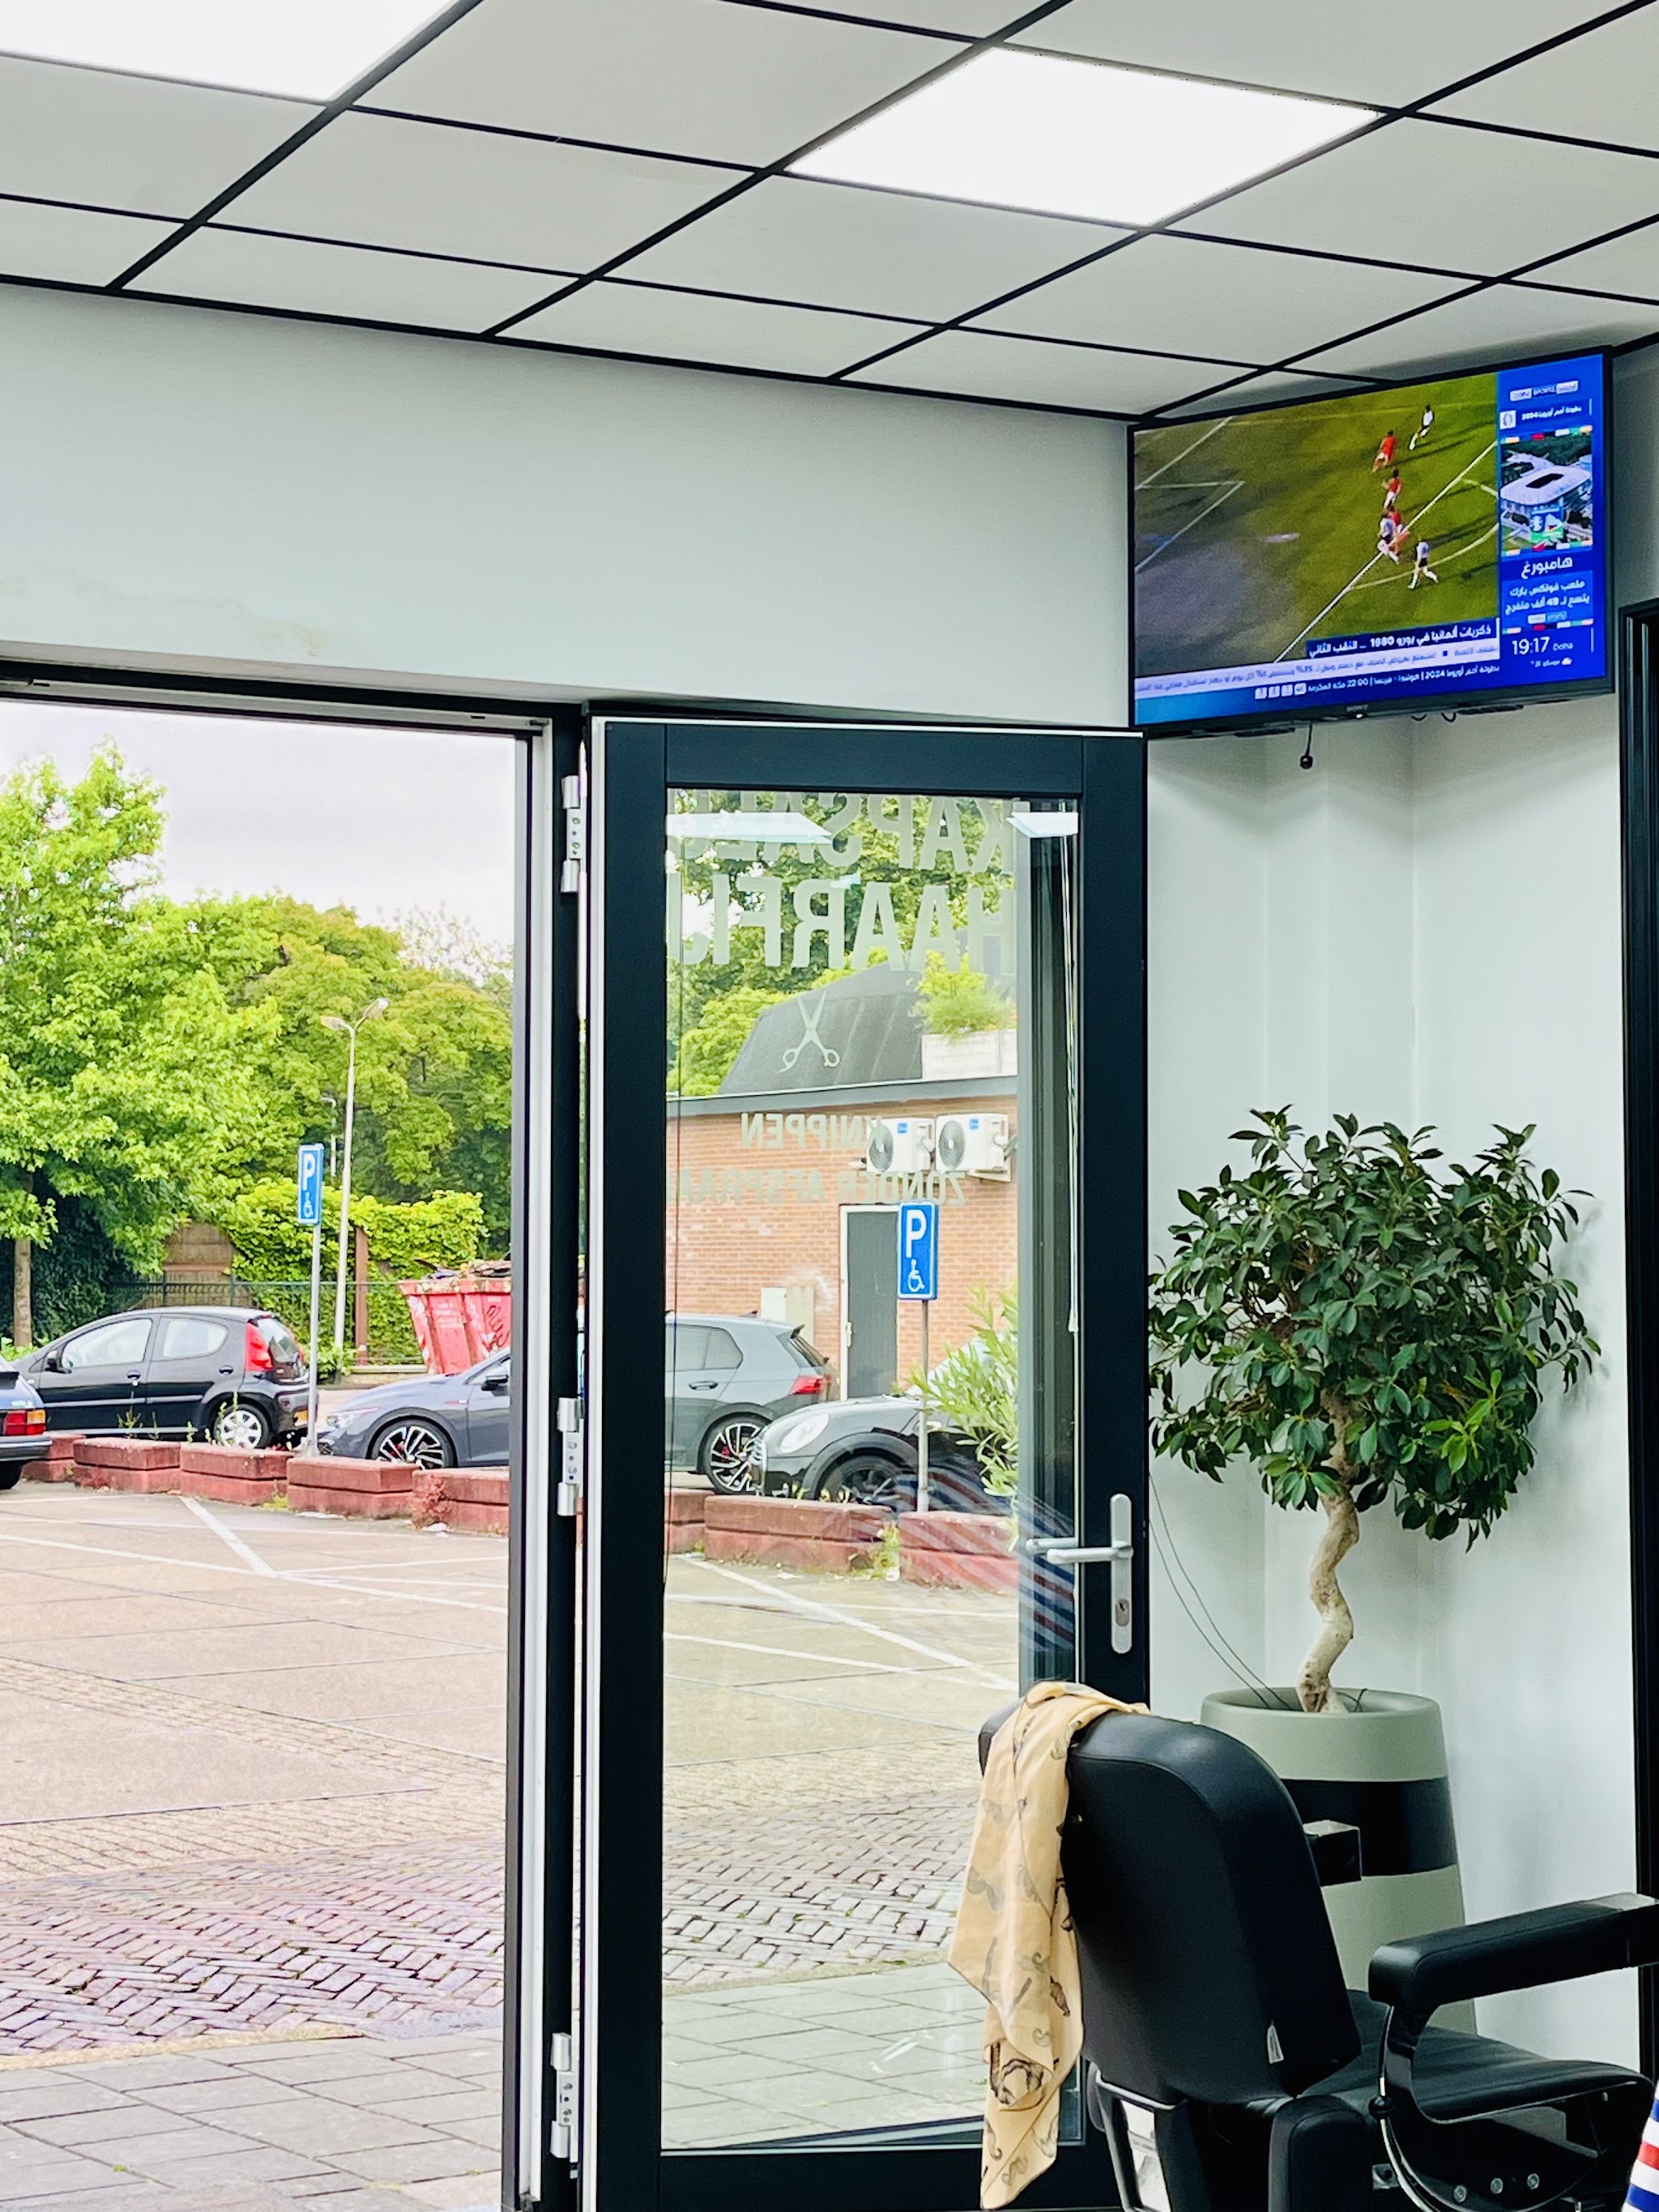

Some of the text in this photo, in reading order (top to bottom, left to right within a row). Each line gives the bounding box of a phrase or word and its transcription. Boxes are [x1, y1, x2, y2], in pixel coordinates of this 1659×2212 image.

[1521, 556, 1573, 580] هامبورغ
[1560, 580, 1586, 590] ملعب
[1531, 595, 1546, 608] ألف
[1567, 594, 1590, 607] يتسع
[1505, 601, 1529, 616] متفرج
[1431, 625, 1458, 642] ألمانيا
[1460, 624, 1492, 638] ذكريات
[1397, 637, 1415, 648] يورو
[1417, 634, 1430, 646] في
[1512, 636, 1550, 655] 19:17
[1309, 642, 1332, 659] الثاني
[302, 1153, 316, 1191] P
[905, 1208, 928, 1259] P
